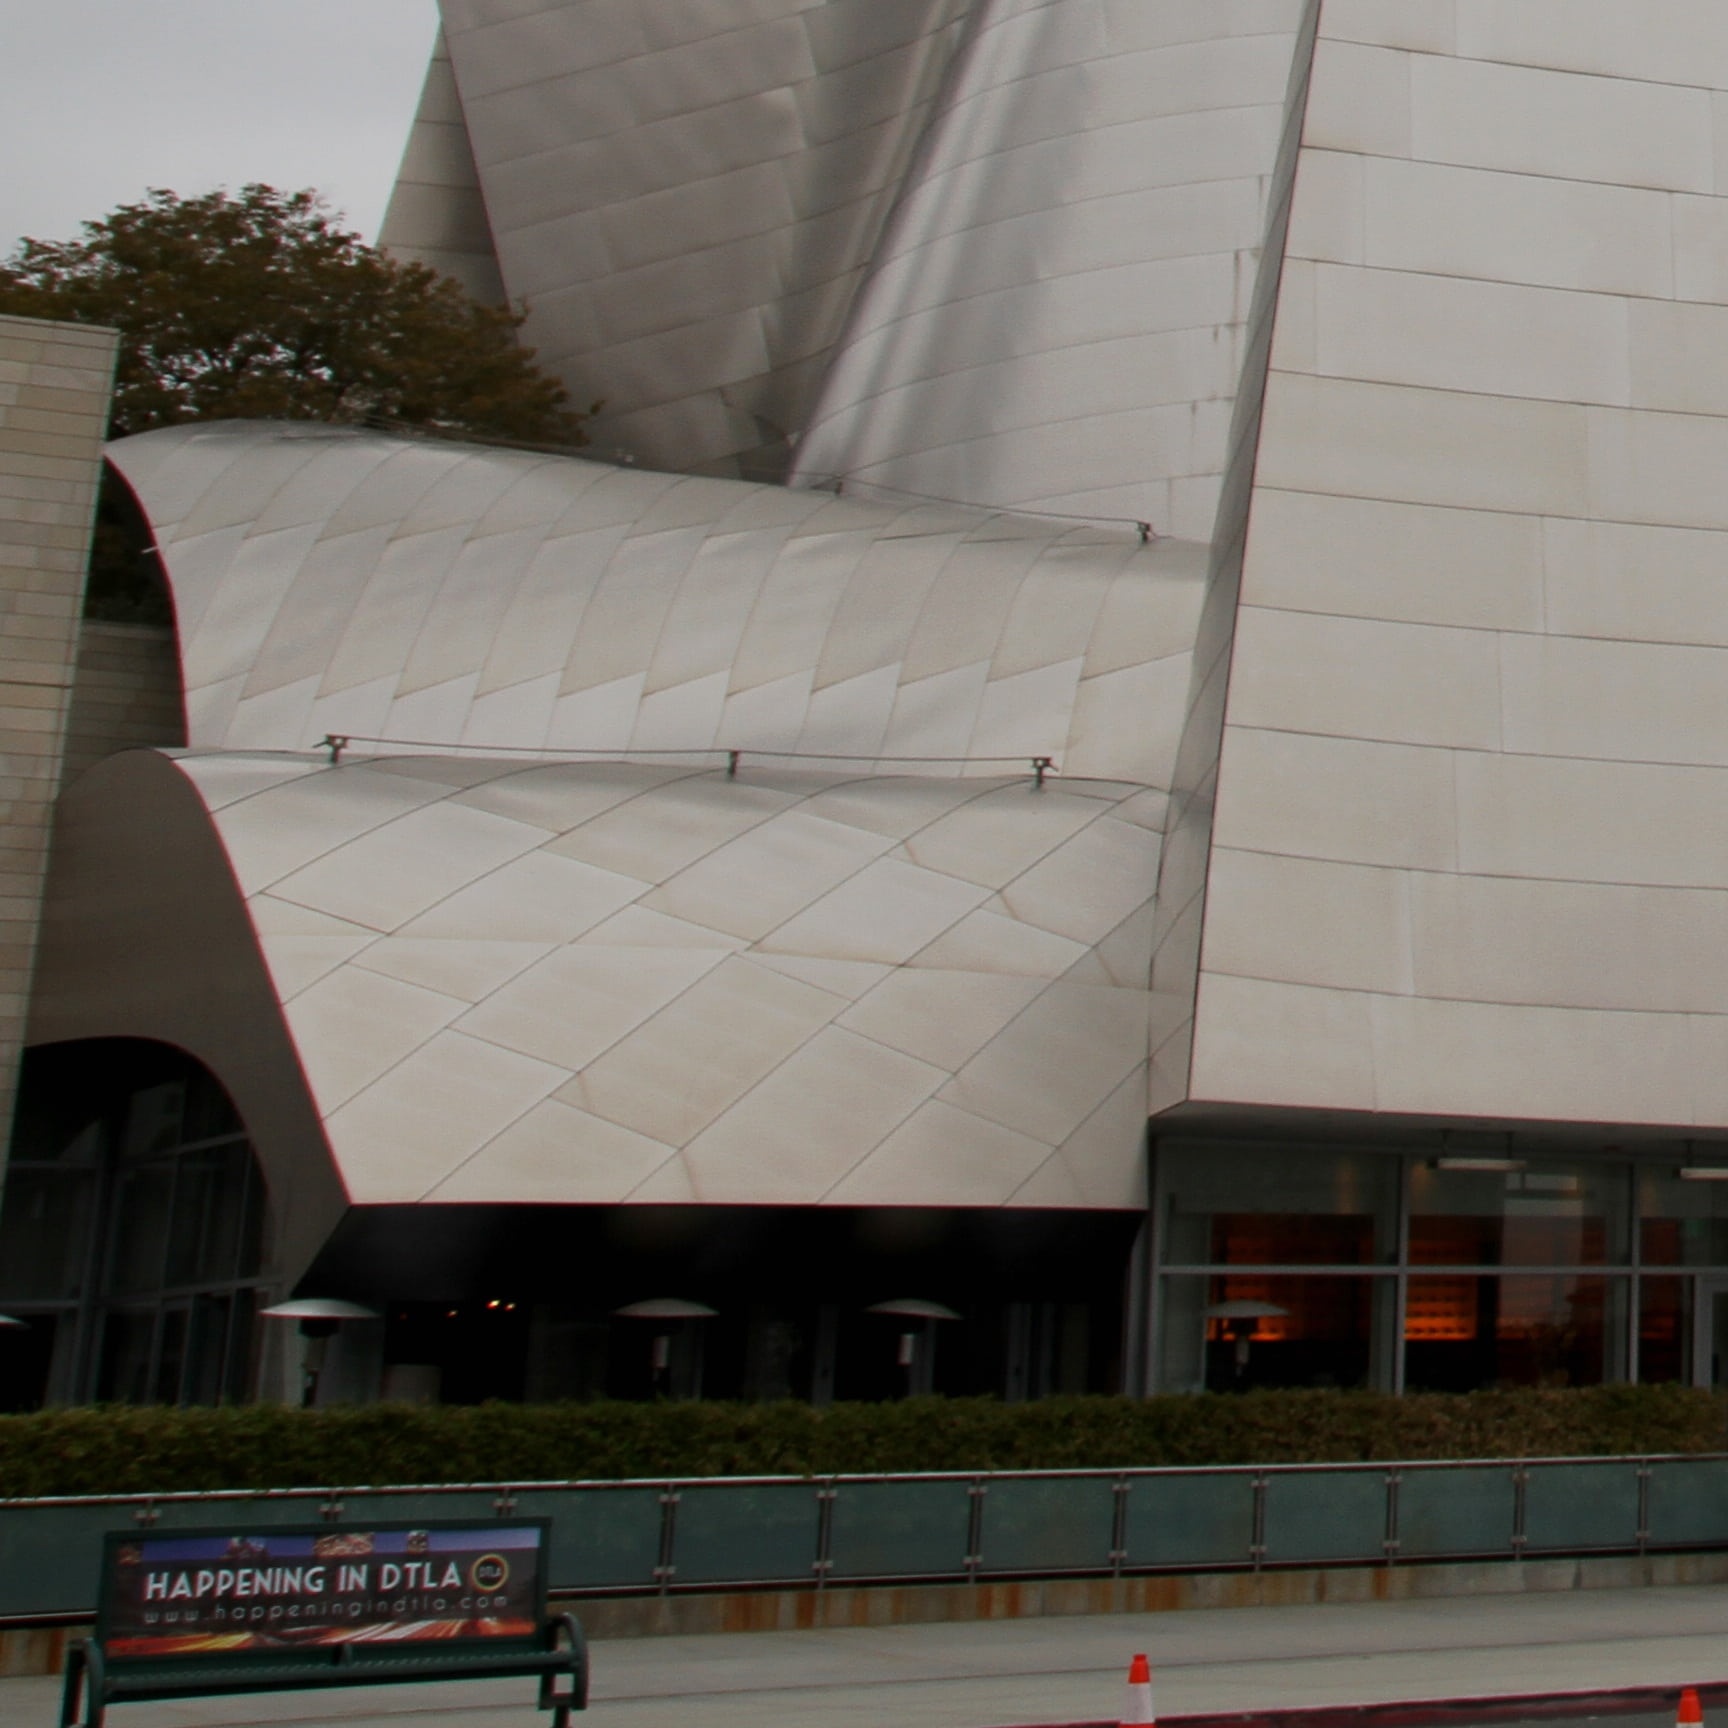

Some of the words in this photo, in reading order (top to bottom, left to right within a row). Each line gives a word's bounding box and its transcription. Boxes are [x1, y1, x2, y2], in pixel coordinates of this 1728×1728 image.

[145, 1565, 326, 1601] HAPPENING
[337, 1562, 368, 1593] IN
[379, 1561, 462, 1592] DTLA
[143, 1594, 508, 1625] www.happeningindtla.com
